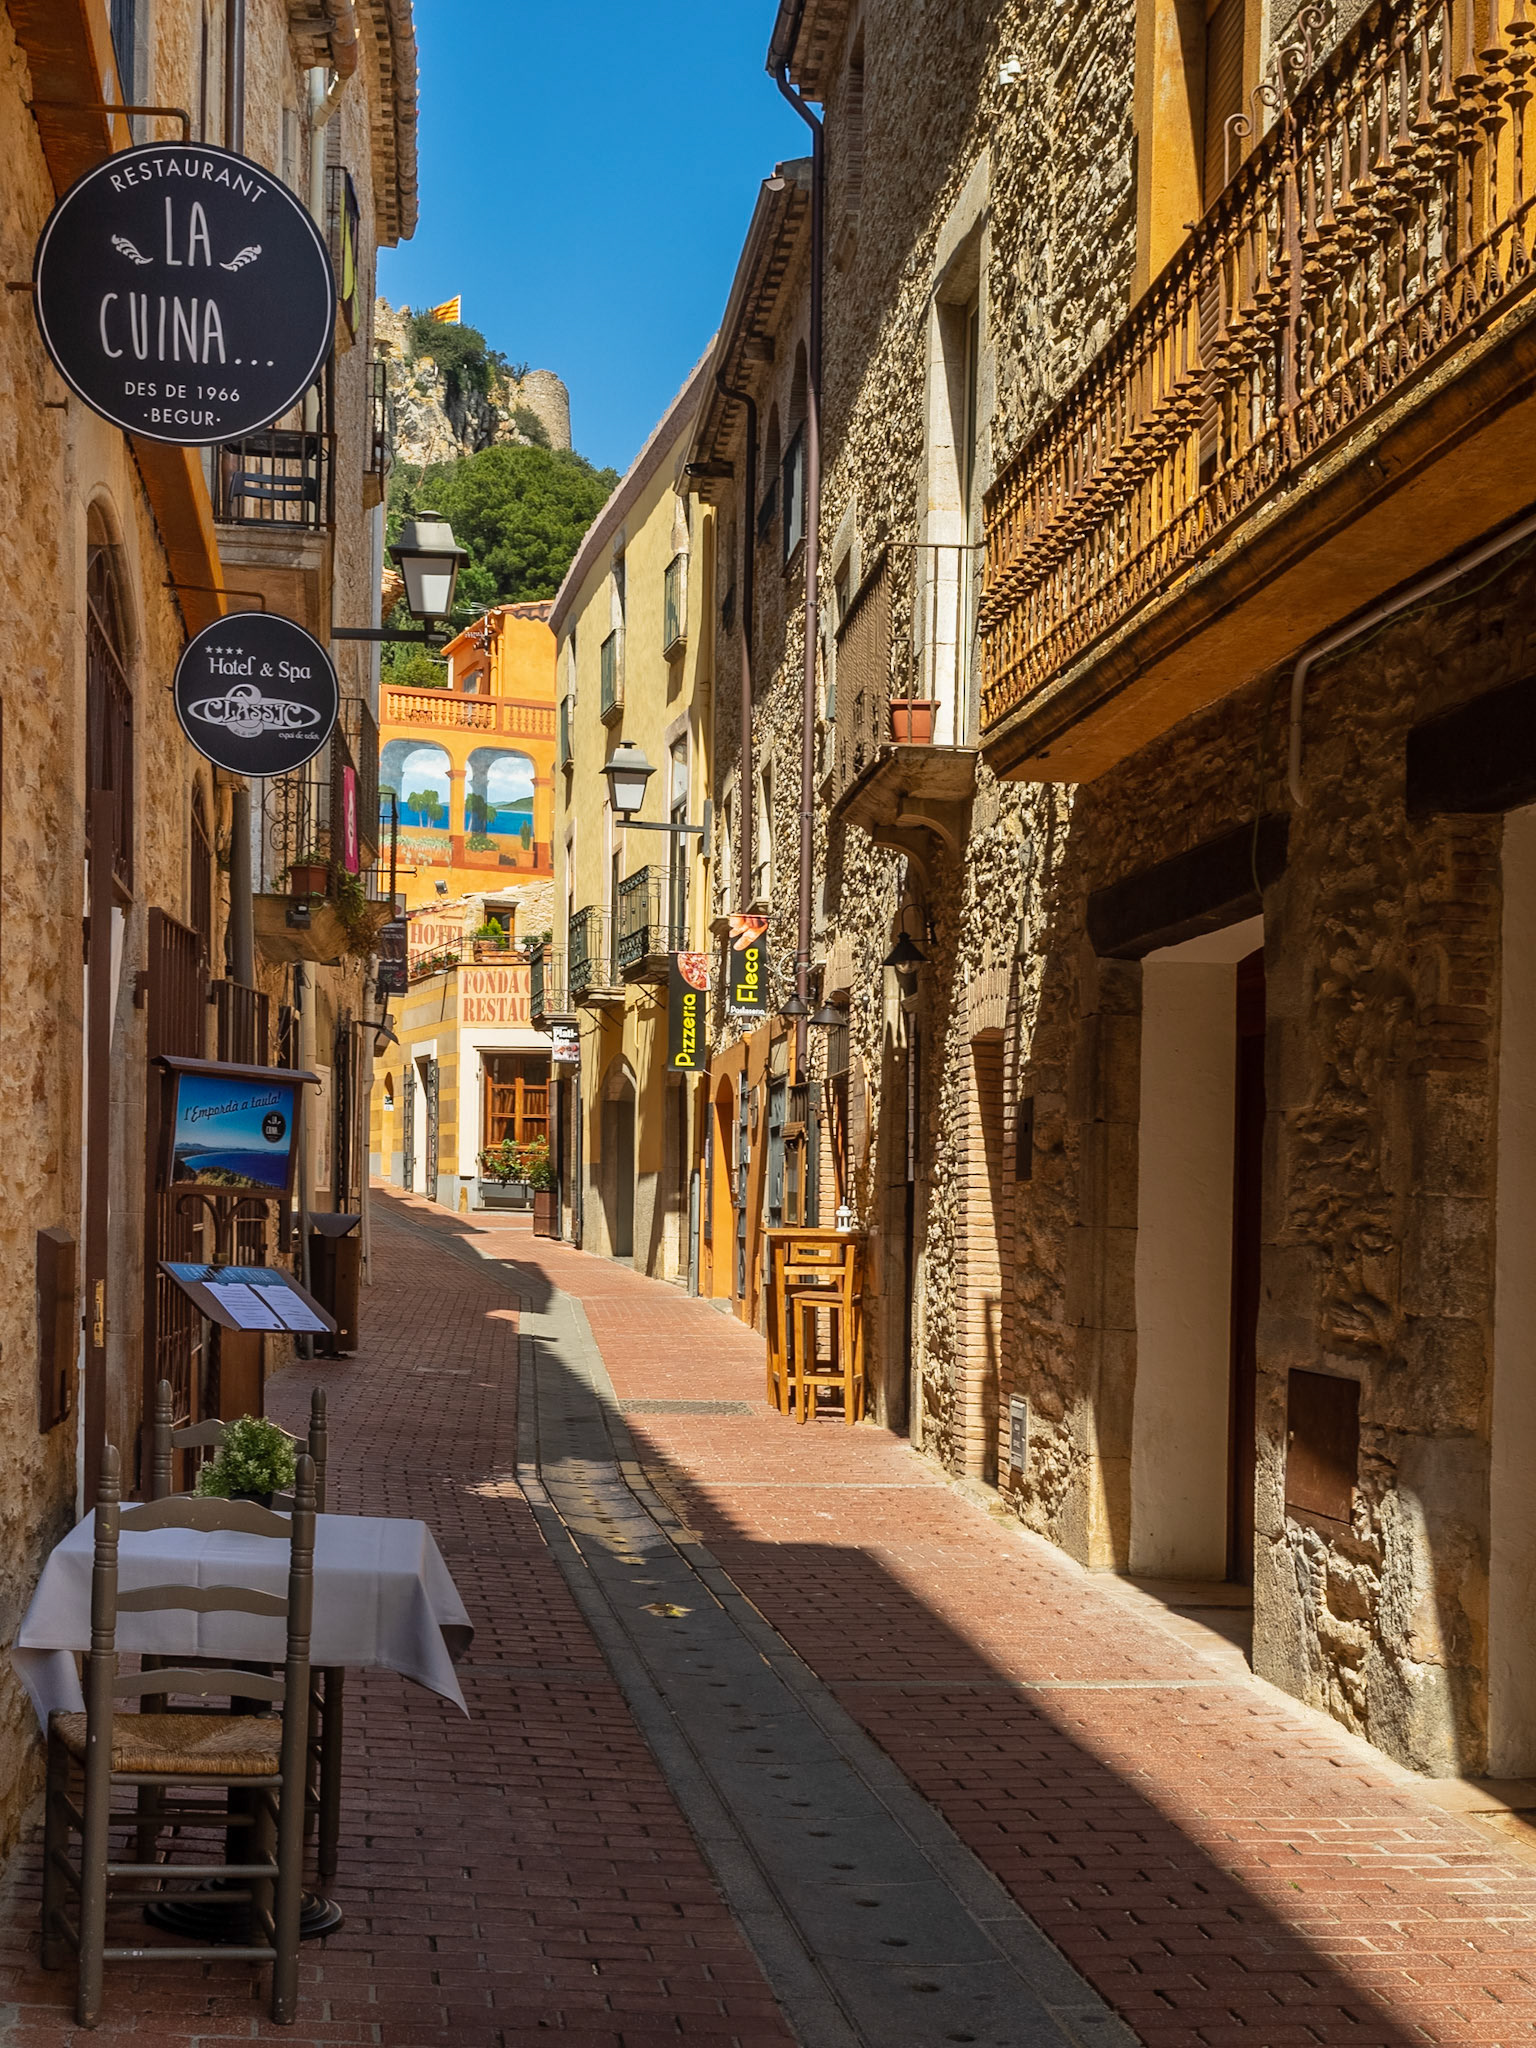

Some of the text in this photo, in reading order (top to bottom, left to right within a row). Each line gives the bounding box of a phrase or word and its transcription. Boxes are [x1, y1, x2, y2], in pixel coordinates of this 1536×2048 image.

[110, 159, 267, 203] RESTAURANT
[165, 196, 212, 267] LA
[100, 291, 274, 366] CUINA...
[124, 381, 240, 402] DES DE 1966
[208, 656, 312, 683] Hotel & Spa
[203, 698, 302, 728] CLASSIC
[462, 970, 520, 994] FONDA
[736, 948, 759, 1003] Fleca
[462, 997, 532, 1023] RESTAU
[675, 993, 697, 1067] Pizzeria
[240, 1101, 249, 1111] a
